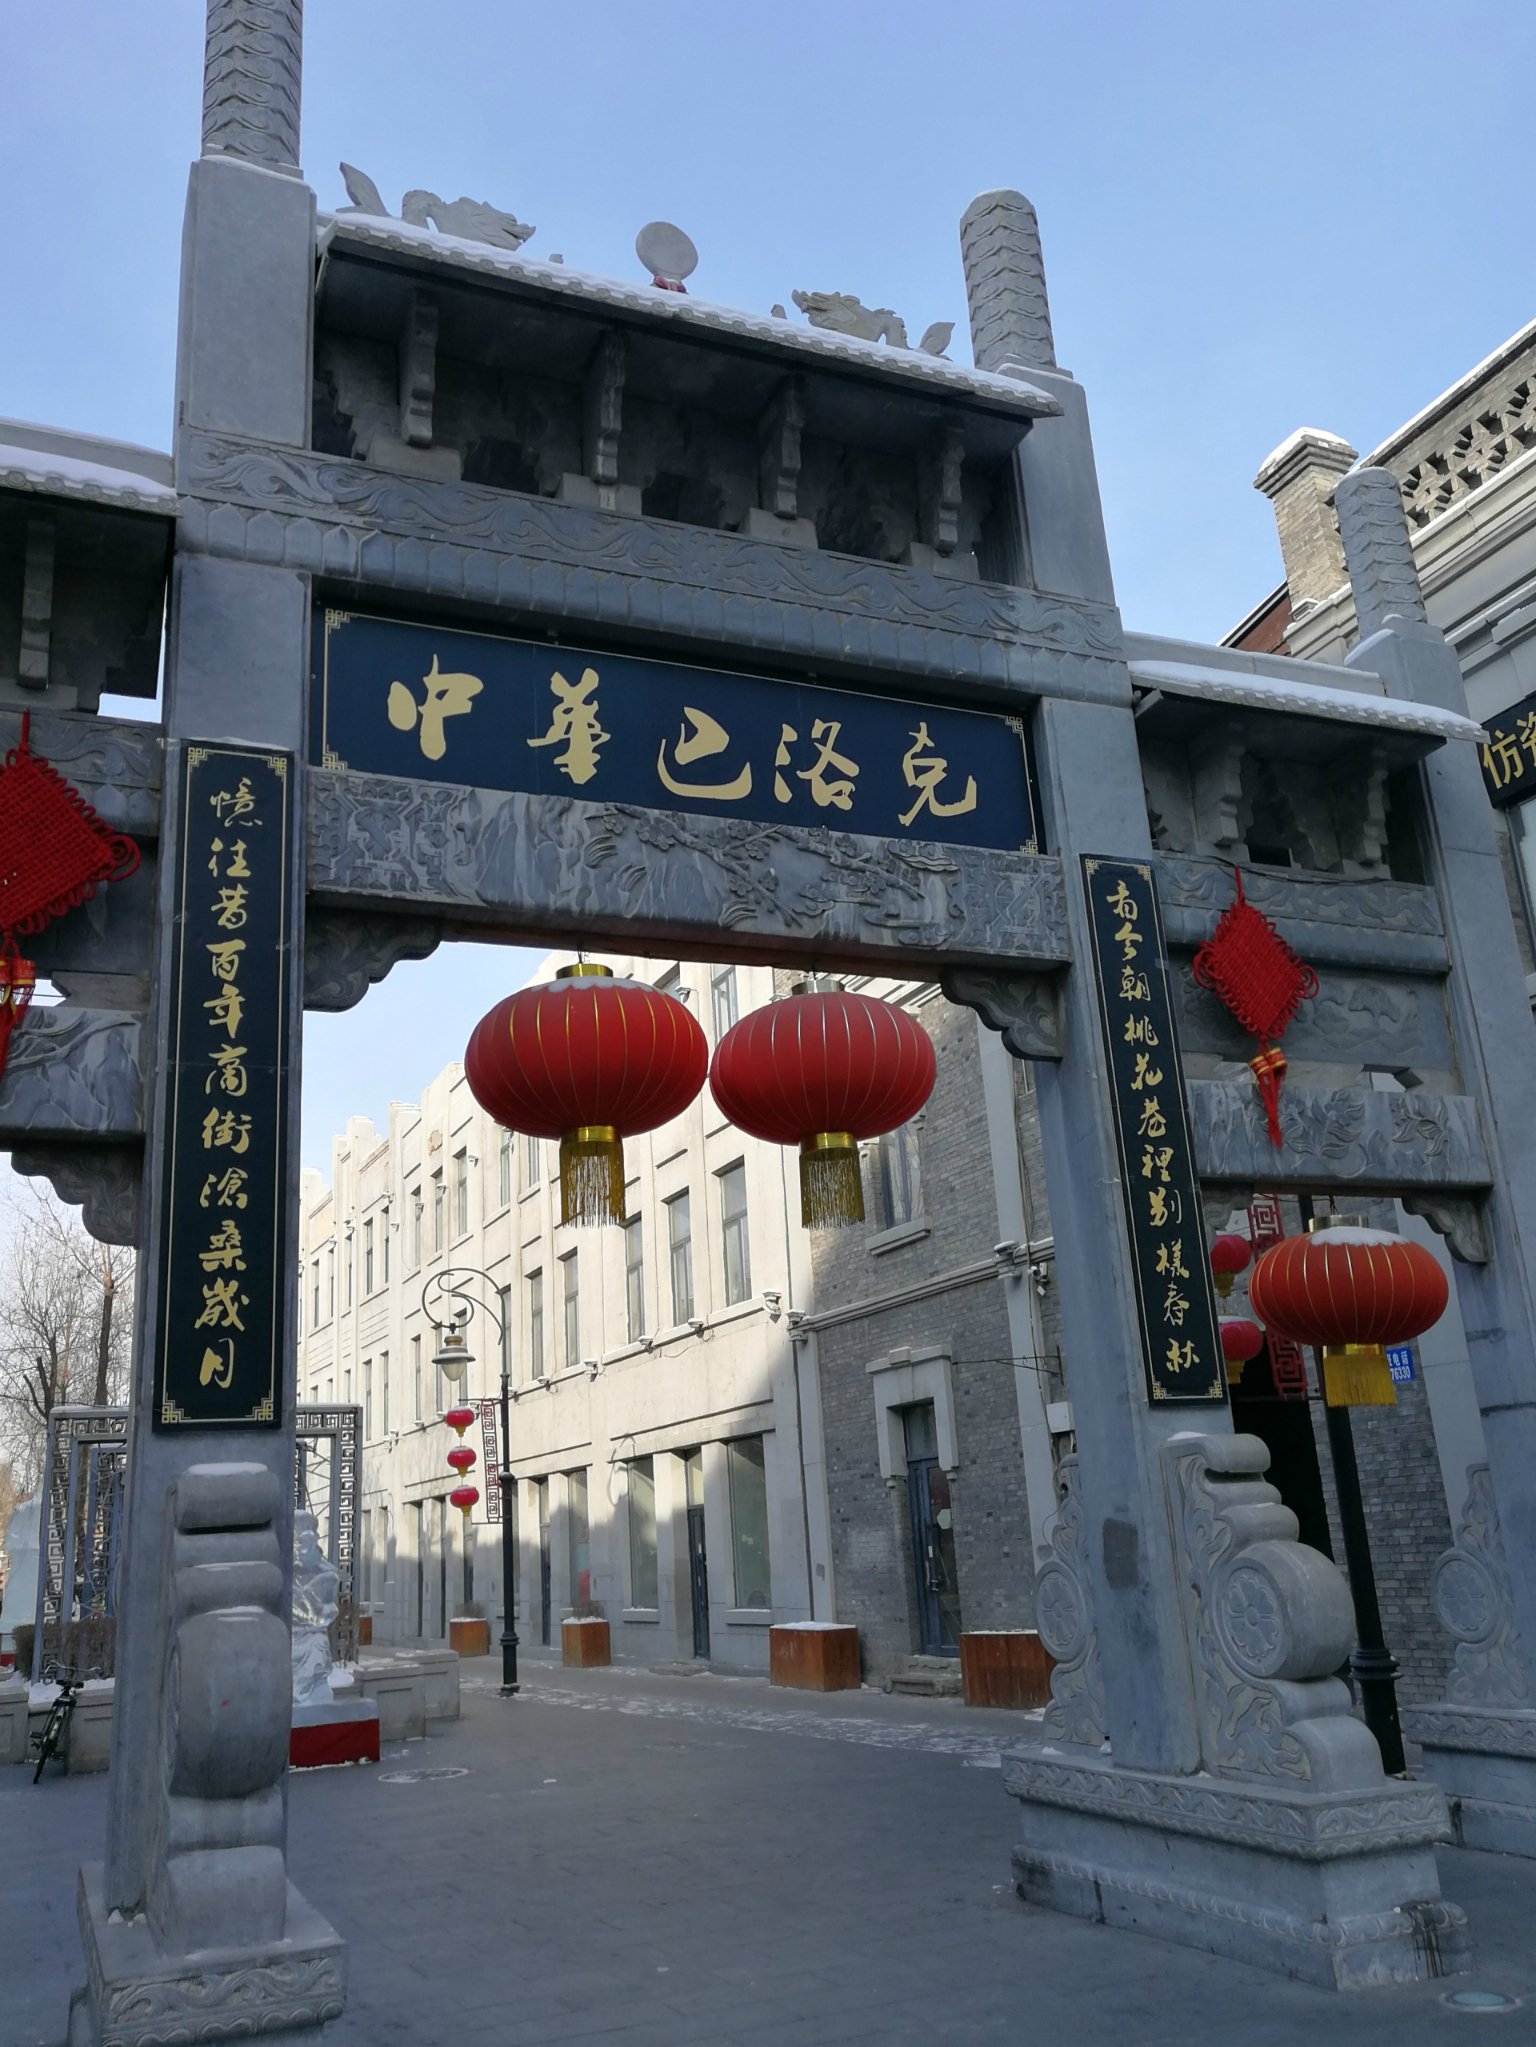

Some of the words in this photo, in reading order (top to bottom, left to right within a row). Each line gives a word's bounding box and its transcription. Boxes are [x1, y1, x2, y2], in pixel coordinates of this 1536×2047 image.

[387, 653, 977, 826] 中華巴洛克
